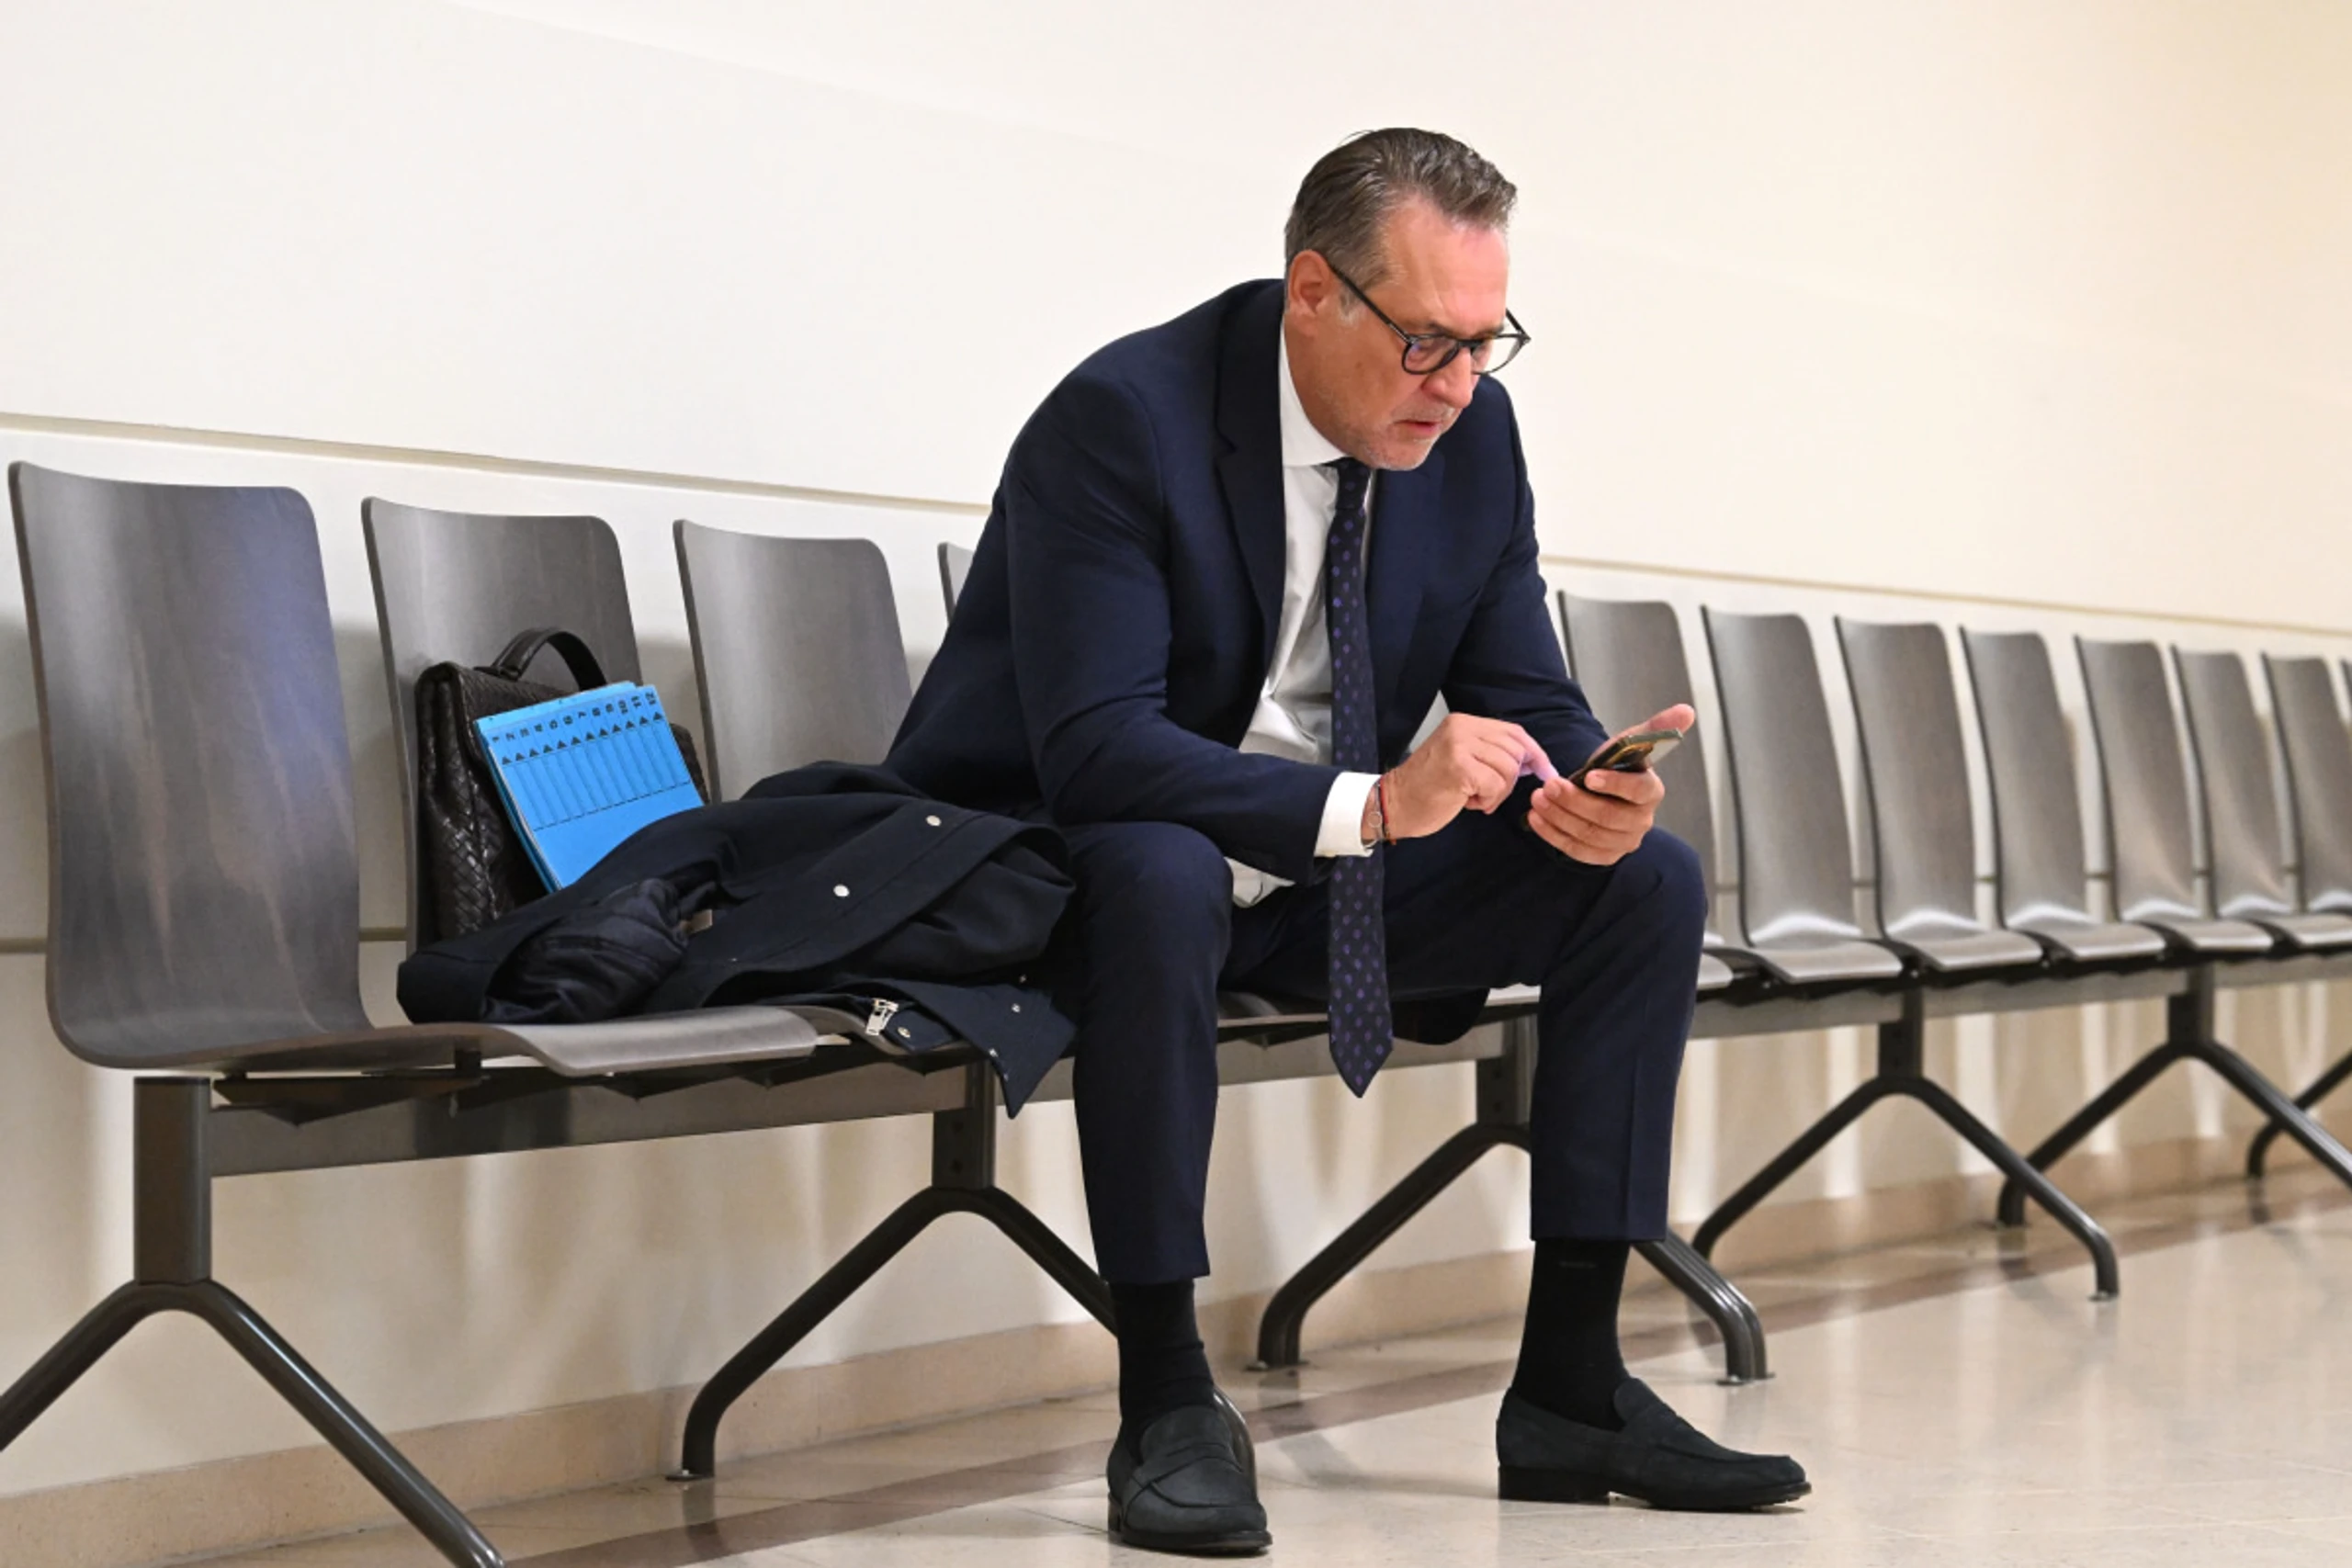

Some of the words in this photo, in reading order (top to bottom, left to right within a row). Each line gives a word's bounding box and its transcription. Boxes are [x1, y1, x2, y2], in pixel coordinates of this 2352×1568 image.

[630, 696, 642, 709] 11
[644, 692, 657, 706] 12
[591, 706, 602, 717] 8
[605, 703, 615, 714] 9
[617, 699, 629, 715] 10
[562, 715, 574, 726] 6
[577, 711, 587, 719] 7
[534, 723, 544, 733] 4
[548, 719, 559, 730] 5
[505, 732, 515, 741] 2
[520, 727, 530, 738] 3
